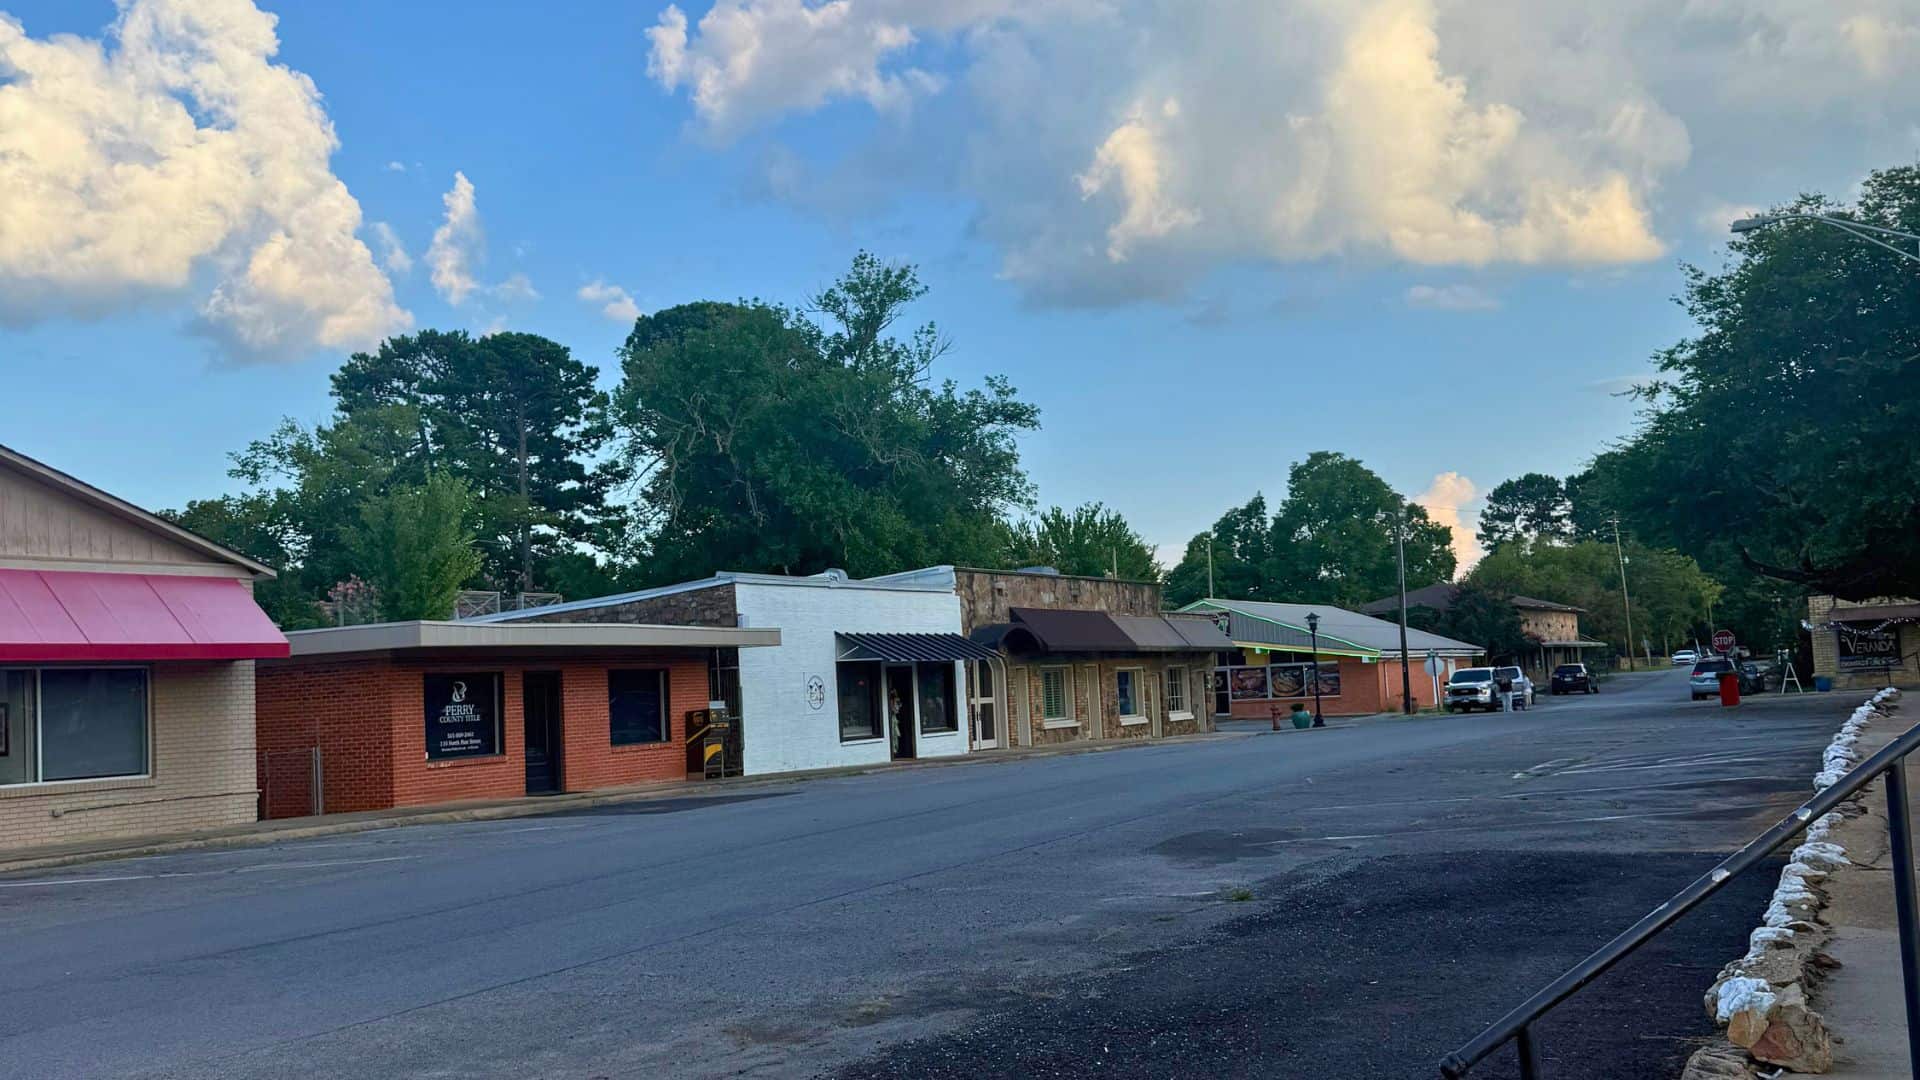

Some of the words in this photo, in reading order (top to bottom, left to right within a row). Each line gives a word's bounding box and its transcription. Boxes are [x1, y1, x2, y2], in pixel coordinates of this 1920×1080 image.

[1714, 636, 1734, 646] STOP
[446, 704, 475, 716] PERRY
[465, 714, 480, 722] TITLE
